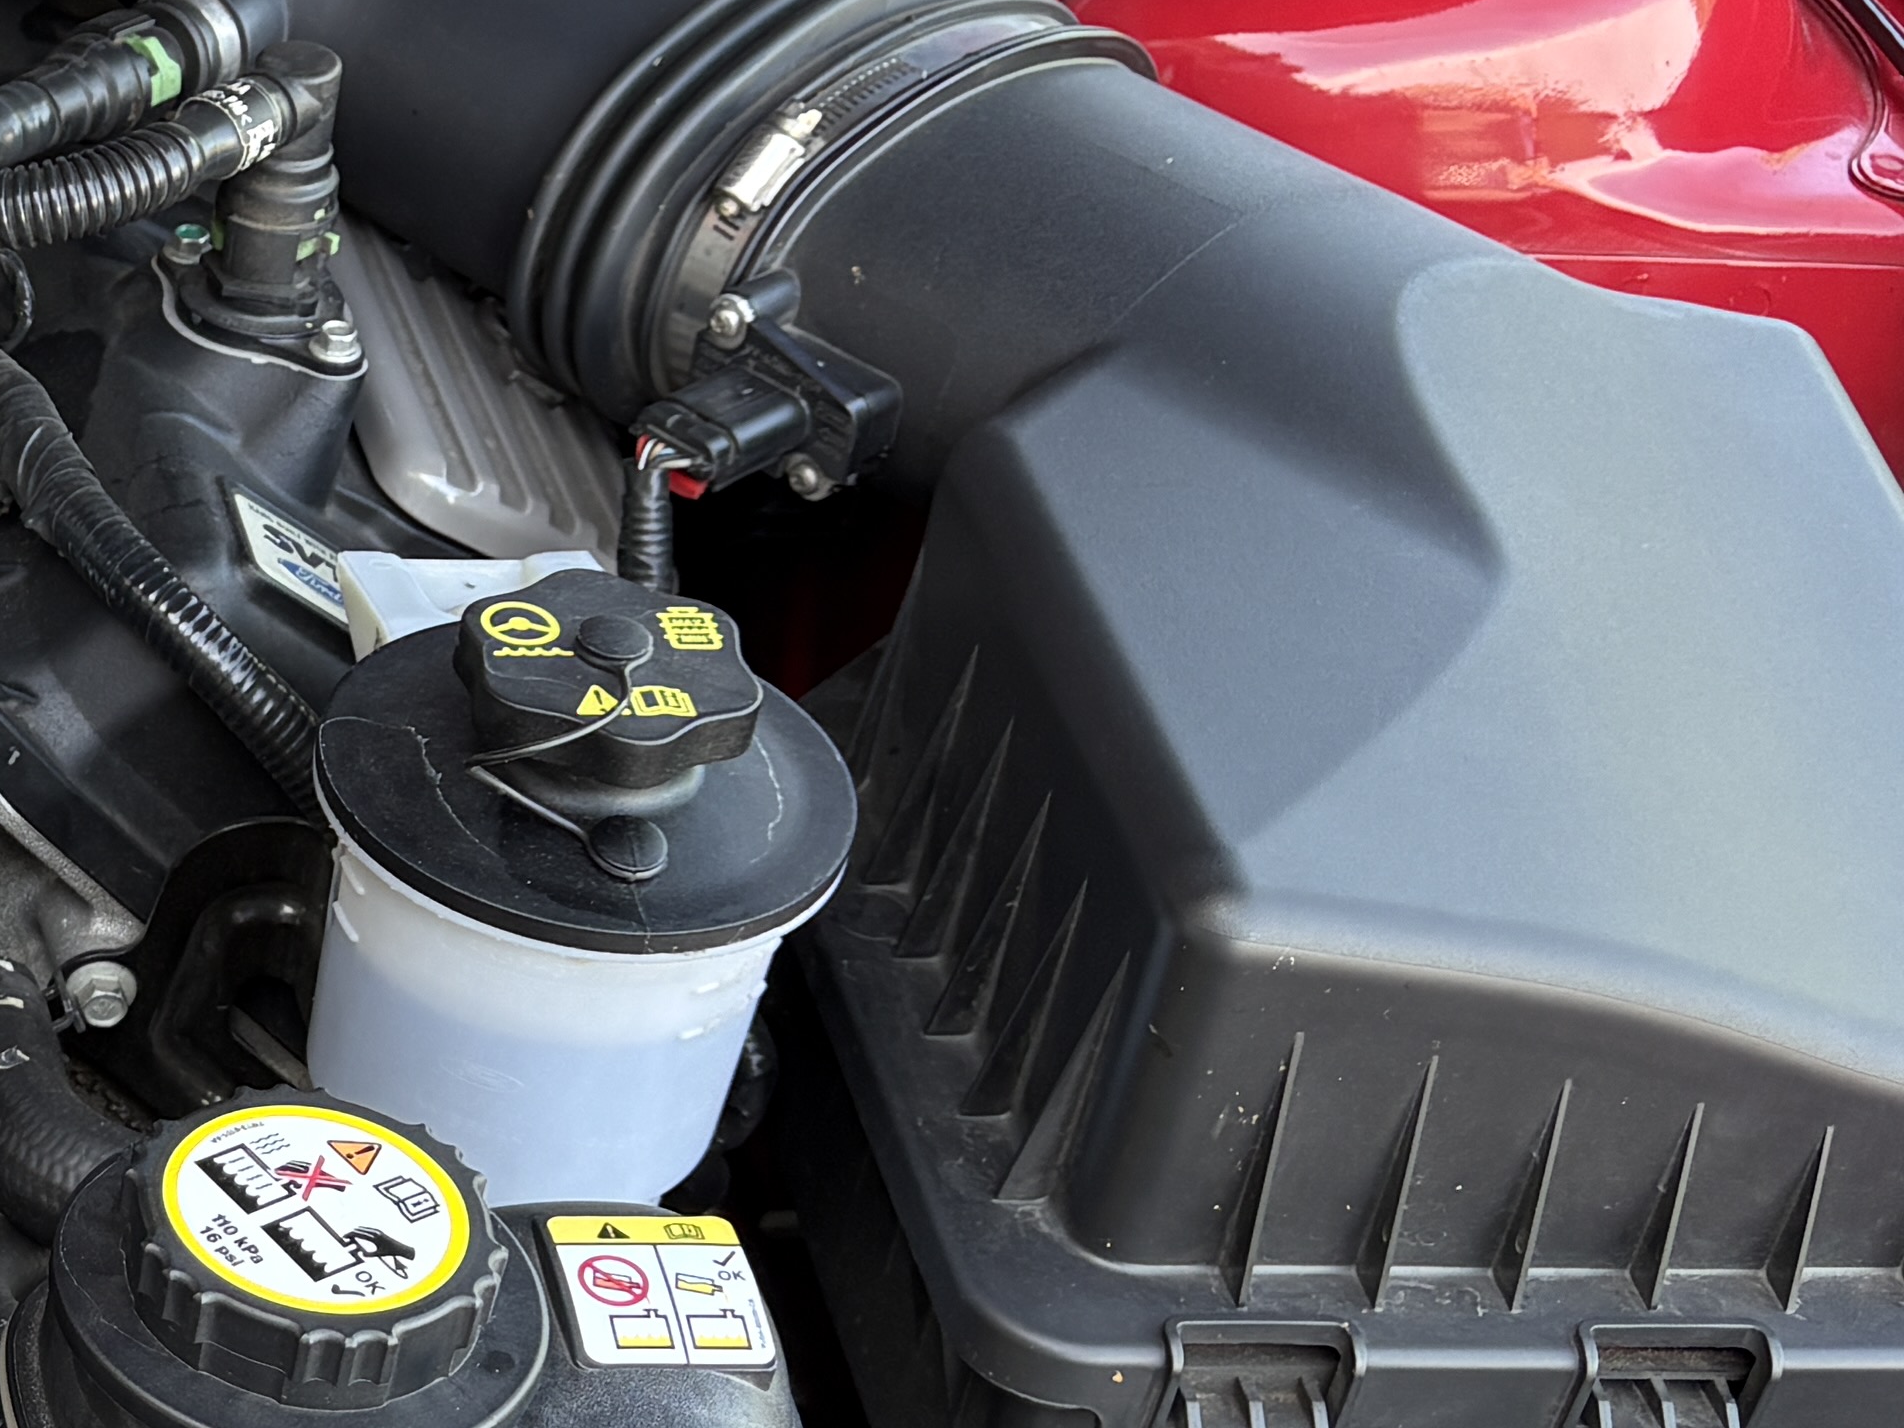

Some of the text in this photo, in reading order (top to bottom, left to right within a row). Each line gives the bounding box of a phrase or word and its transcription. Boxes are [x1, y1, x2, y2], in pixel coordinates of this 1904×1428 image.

[200, 1225, 221, 1245] 16
[233, 1233, 264, 1266] kPa
[354, 1269, 386, 1296] OK
[718, 1270, 747, 1282] OK
